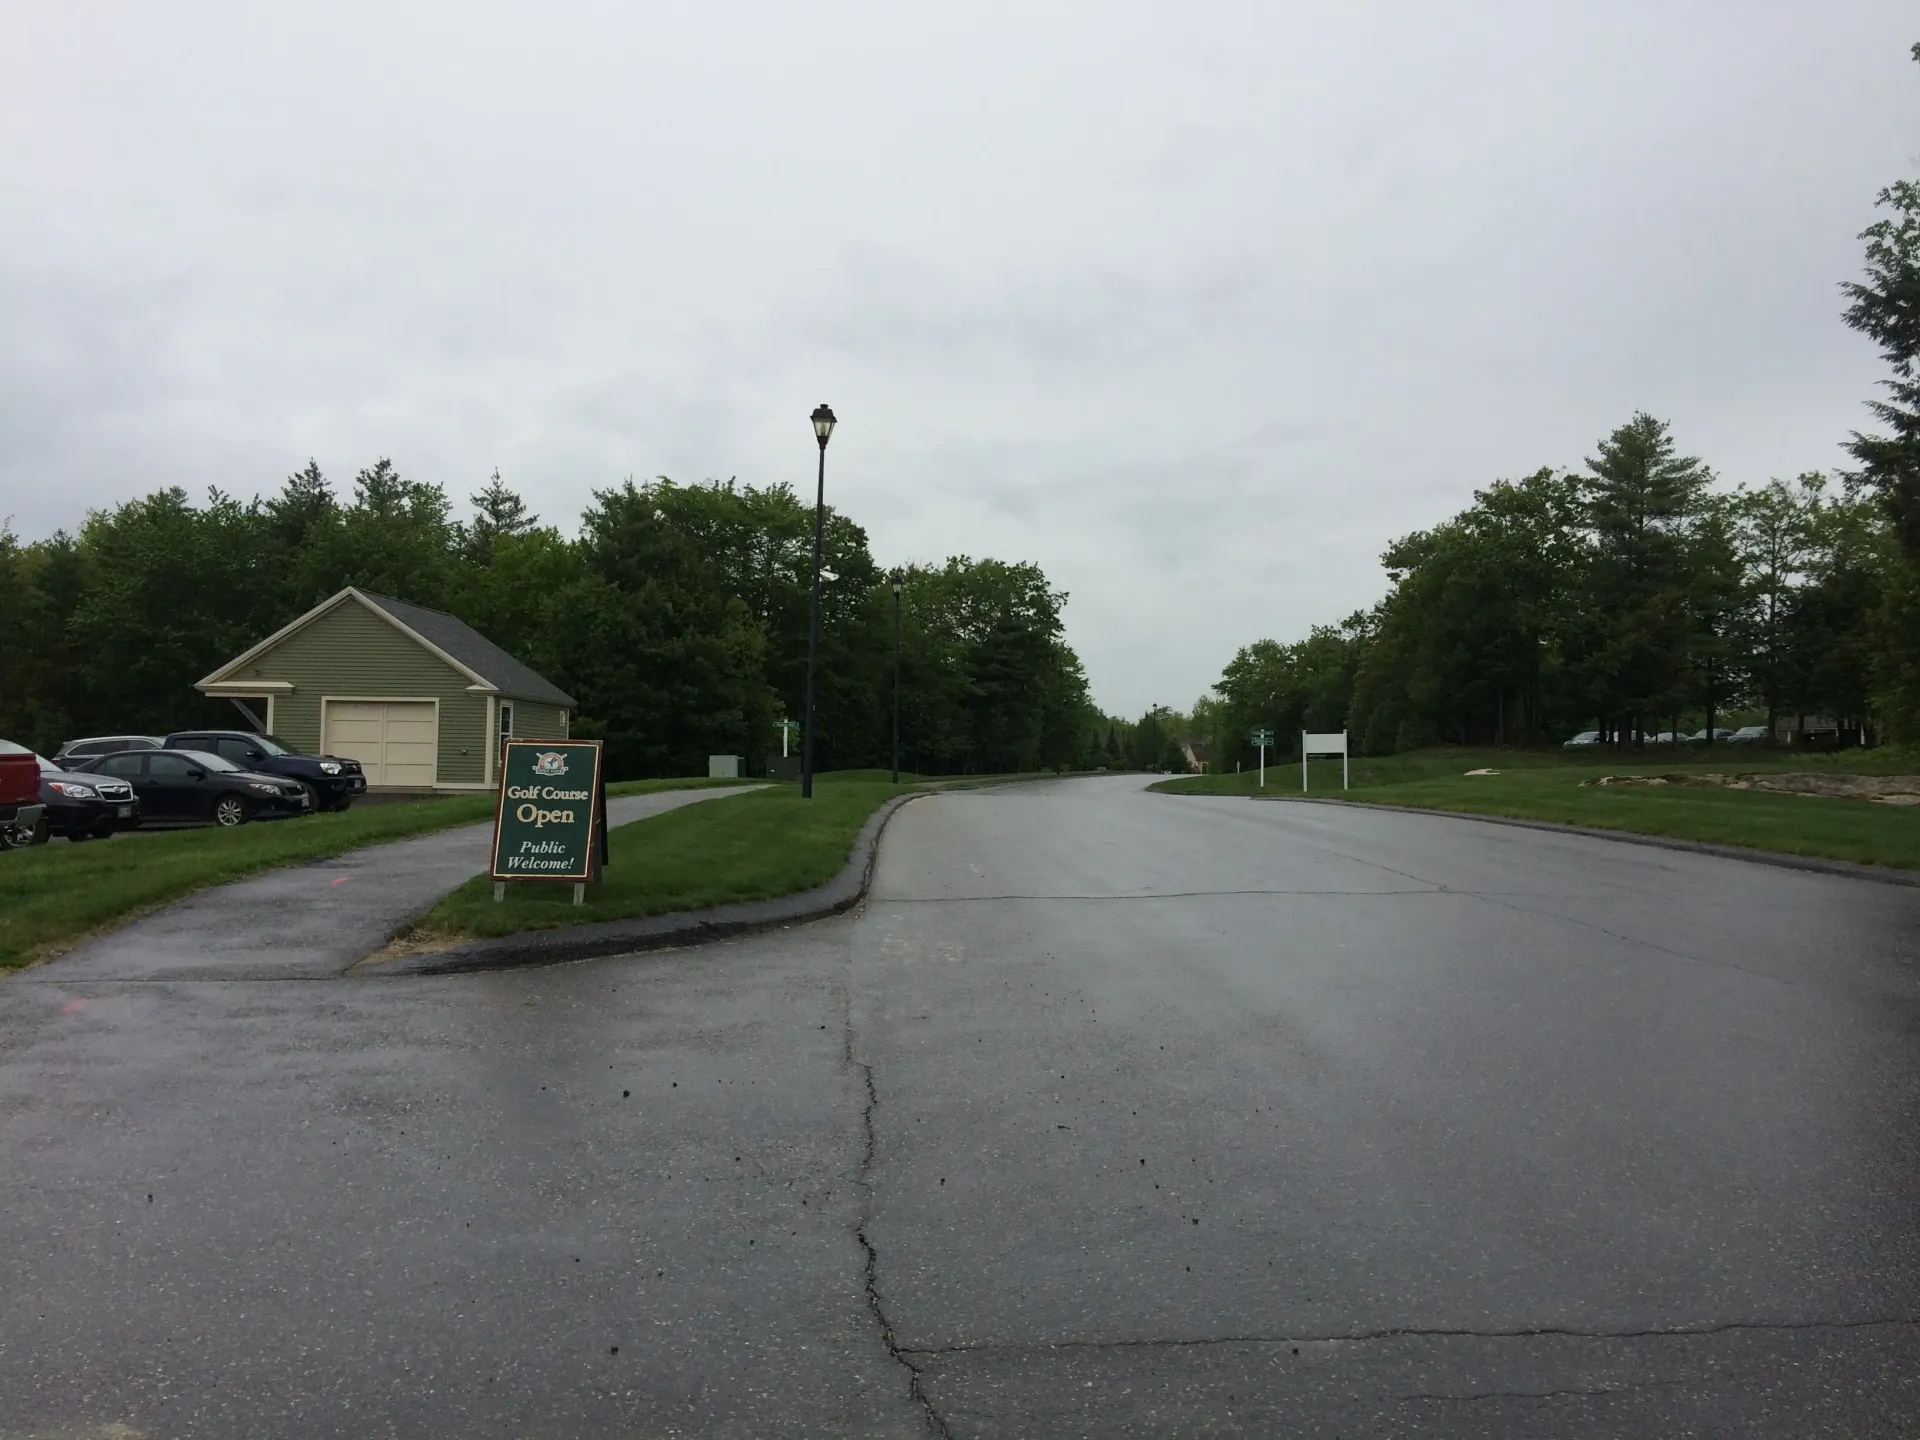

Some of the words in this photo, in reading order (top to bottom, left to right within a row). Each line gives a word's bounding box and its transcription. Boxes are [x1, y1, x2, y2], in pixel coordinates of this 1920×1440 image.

[507, 786, 541, 799] Golf
[542, 787, 588, 800] Course
[516, 804, 574, 828] Open
[520, 841, 566, 854] Public
[508, 856, 574, 870] Welcome!
